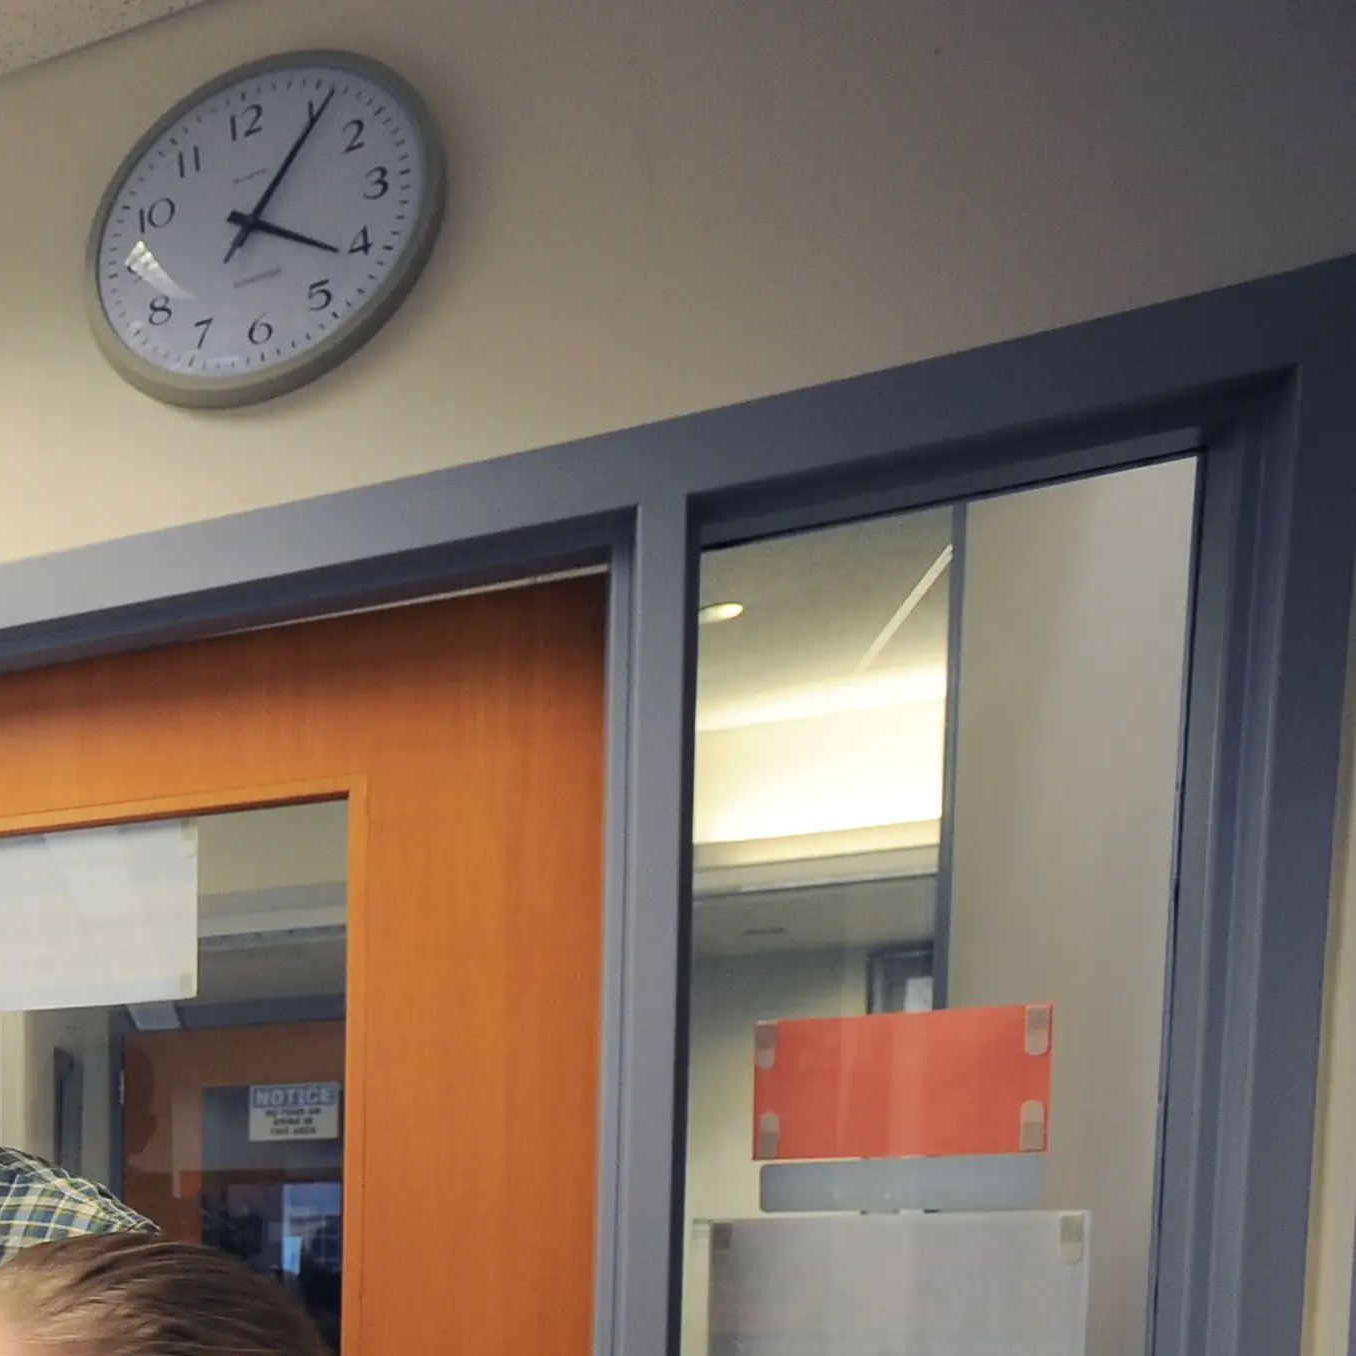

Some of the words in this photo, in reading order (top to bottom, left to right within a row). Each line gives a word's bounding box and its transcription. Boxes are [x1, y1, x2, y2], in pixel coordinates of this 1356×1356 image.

[228, 104, 263, 142] 12
[342, 119, 365, 154] 2
[177, 145, 202, 178] 11
[362, 166, 389, 200] 3
[138, 197, 176, 234] 10
[347, 225, 373, 255] 4
[148, 295, 173, 326] 8
[307, 279, 333, 311] 5
[194, 318, 214, 349] 7
[248, 312, 274, 345] 6
[255, 1087, 335, 1106] NOTICE
